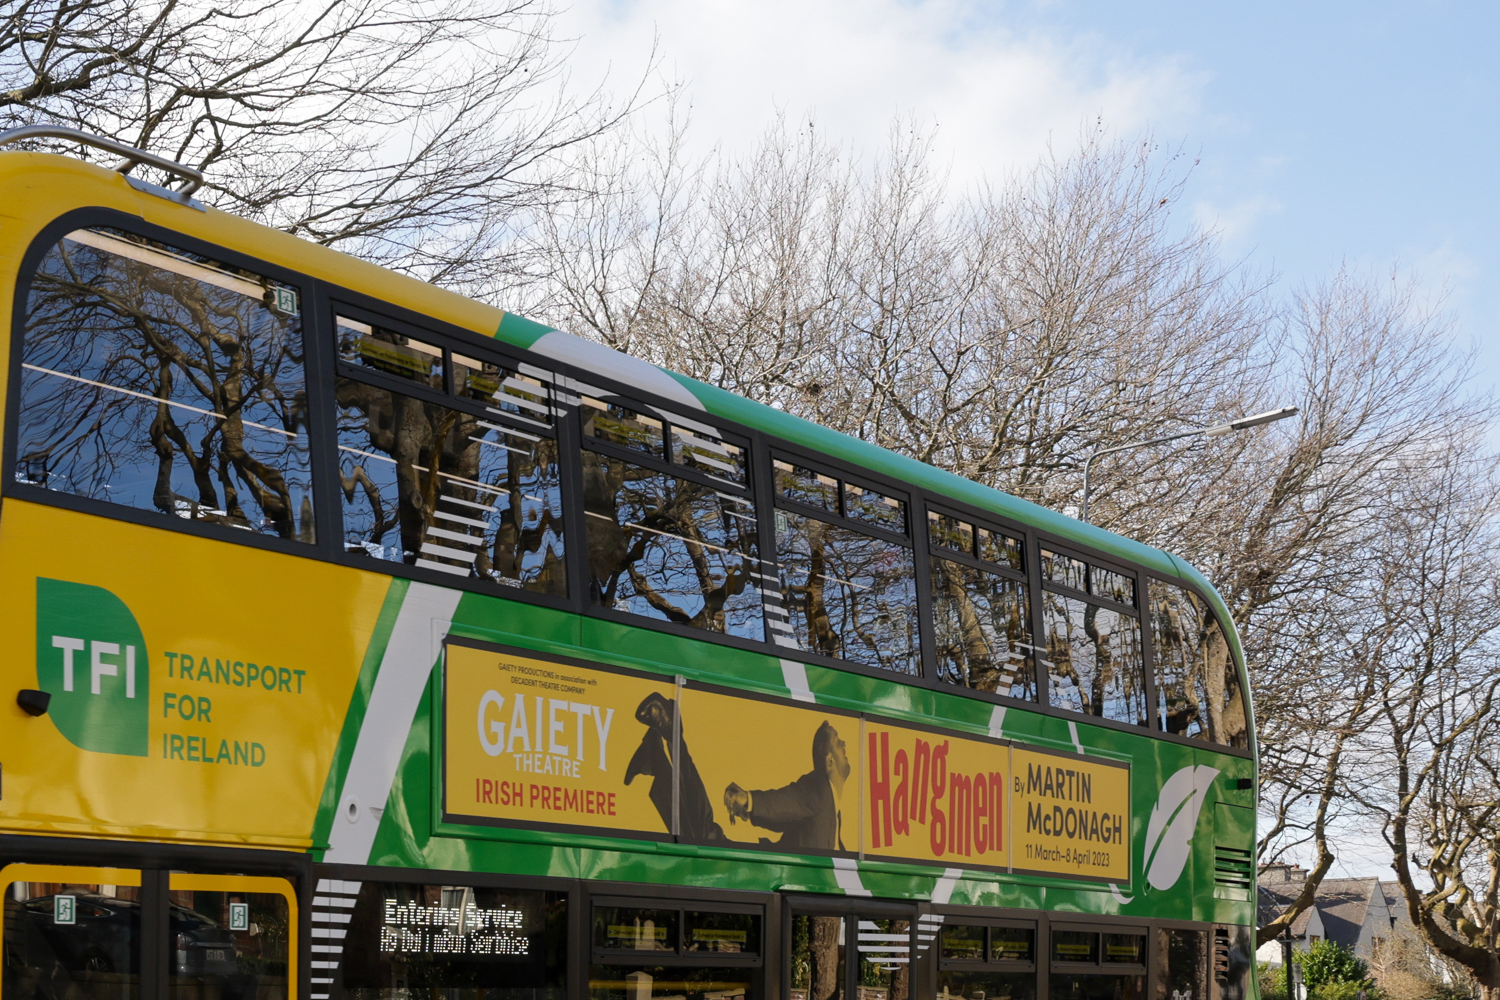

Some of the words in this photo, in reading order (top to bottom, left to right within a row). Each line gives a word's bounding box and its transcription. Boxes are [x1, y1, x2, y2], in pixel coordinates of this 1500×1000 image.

[52, 635, 136, 699] TFI
[164, 651, 307, 694] TRANSPORT
[498, 662, 518, 673] GAIETY
[518, 665, 555, 679] PRODUCTIONS
[555, 672, 560, 680] in
[560, 675, 587, 685] association
[587, 678, 598, 686] with
[510, 676, 538, 688] DECADENT
[538, 680, 560, 692] THEATRE
[560, 684, 586, 695] COMPANY
[163, 692, 213, 723] FOR
[477, 689, 615, 772] GAIETY
[163, 733, 266, 768] IRELAND
[513, 753, 581, 778] THEATRE
[476, 778, 524, 808] IRISH
[530, 781, 617, 816] PREMIERE
[868, 731, 1003, 858] Hangmen
[1014, 776, 1026, 798] By
[1028, 763, 1092, 804] MARTIN
[1026, 801, 1123, 846] McDONAGH
[1026, 843, 1033, 859] 11
[1072, 848, 1091, 869] April
[1092, 852, 1110, 868] 2023
[385, 898, 460, 926] Entering
[465, 902, 523, 929] Service
[380, 926, 398, 952] Ag
[401, 927, 422, 953] Dul
